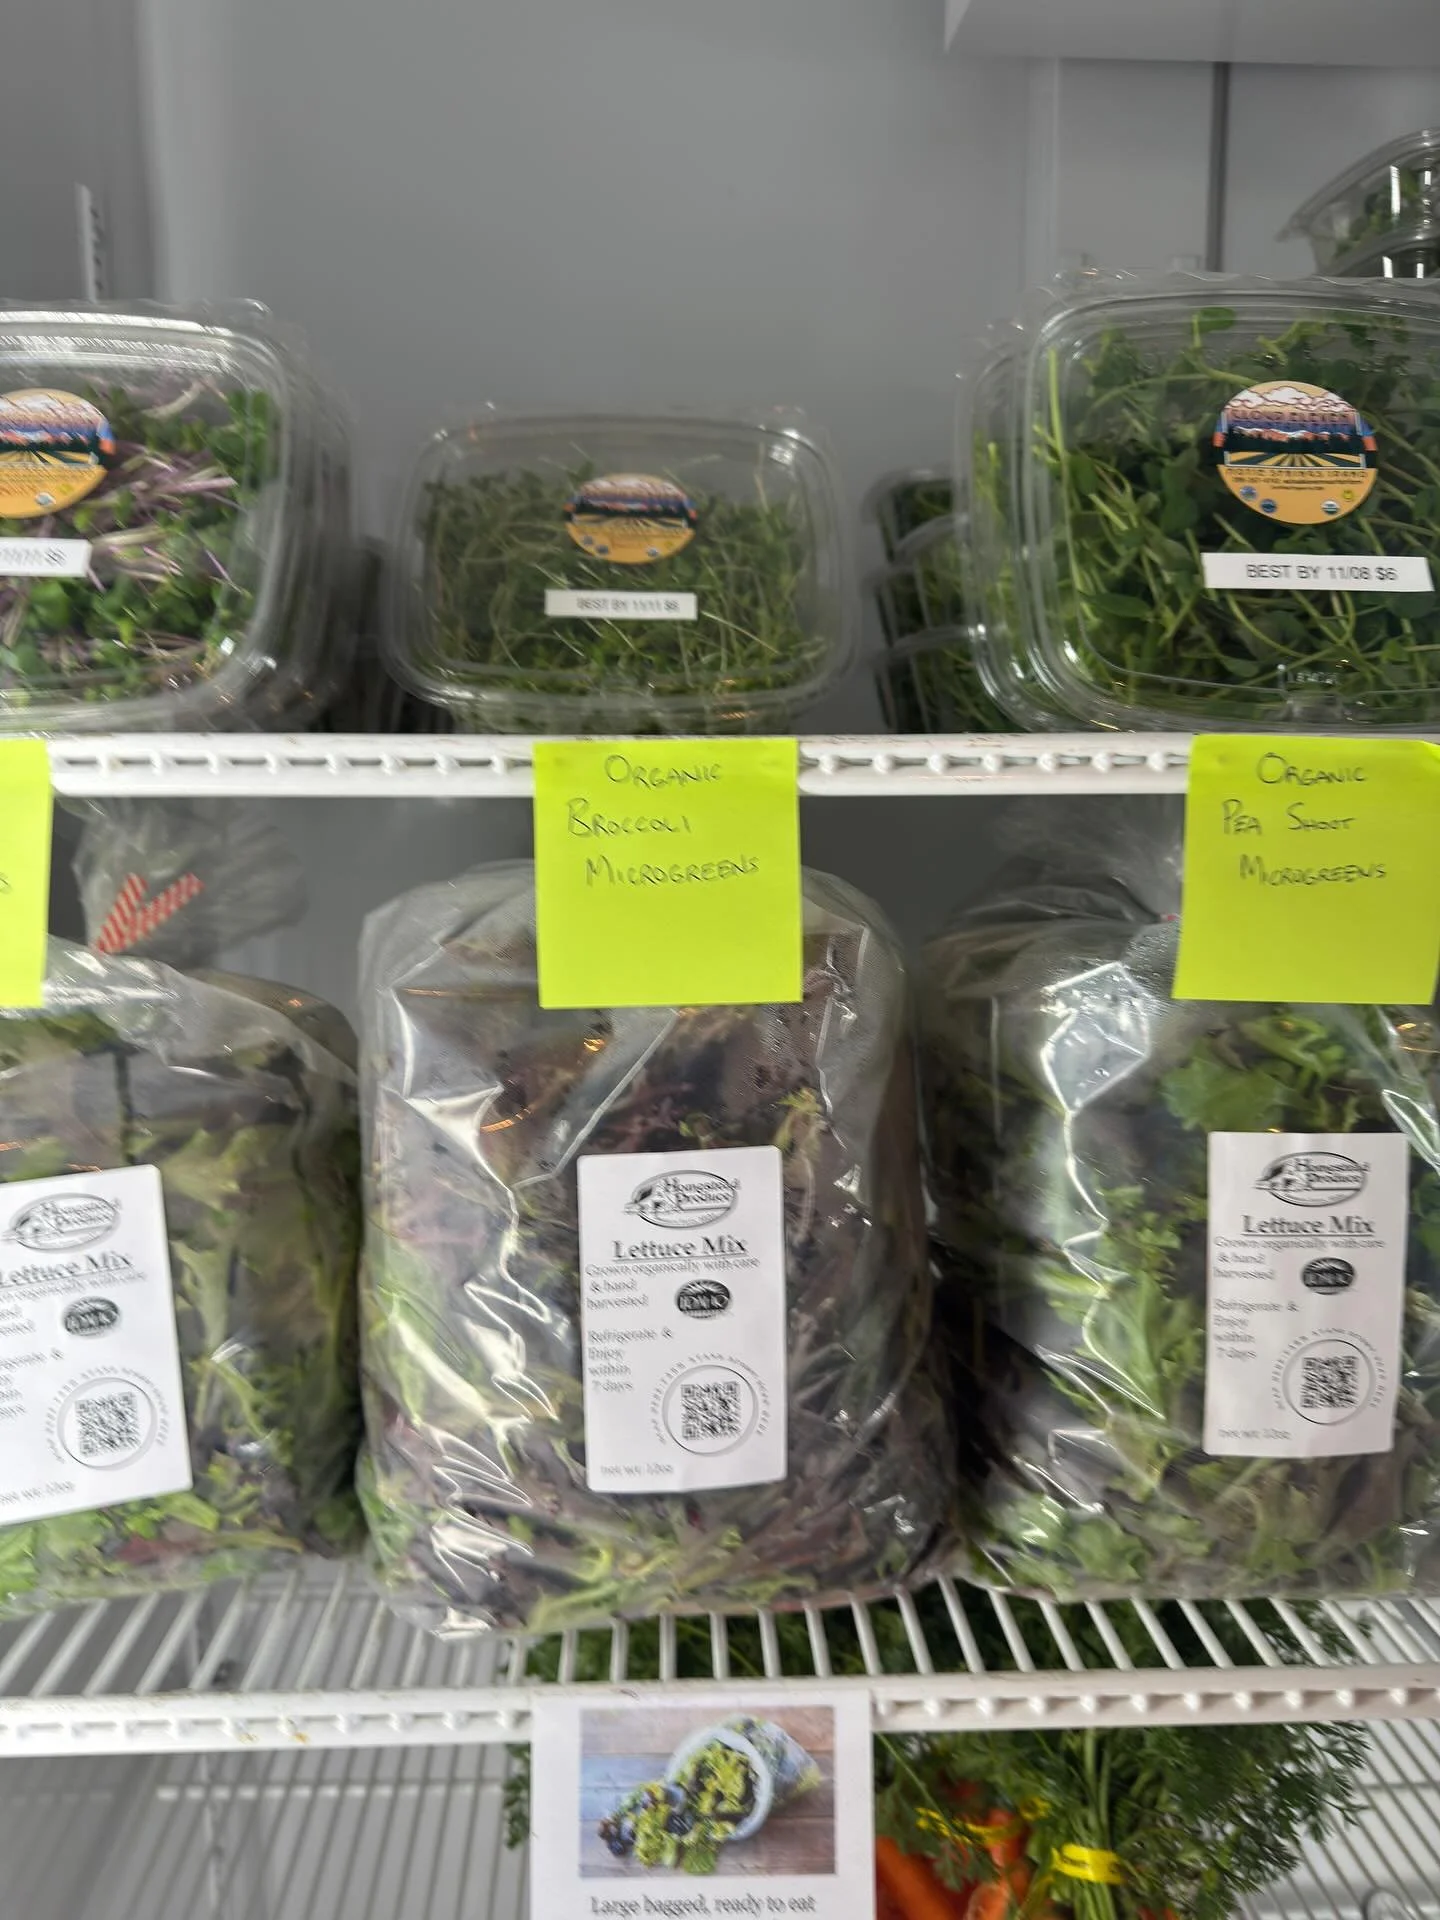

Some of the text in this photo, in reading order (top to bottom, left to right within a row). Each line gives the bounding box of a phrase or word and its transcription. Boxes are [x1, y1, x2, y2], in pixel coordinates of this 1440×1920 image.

[1245, 563, 1398, 581] BEST BY 11/08 $6
[1306, 1170, 1362, 1184] Produce
[675, 1190, 735, 1204] Produce
[1242, 1214, 1376, 1234] Lettuce Mix
[613, 1235, 749, 1259] Lettuce Mix
[86, 1250, 134, 1272] Mix
[591, 1895, 640, 1918] Large
[714, 1893, 763, 1918] ready
[766, 1895, 787, 1912] to
[788, 1895, 818, 1912] eat
